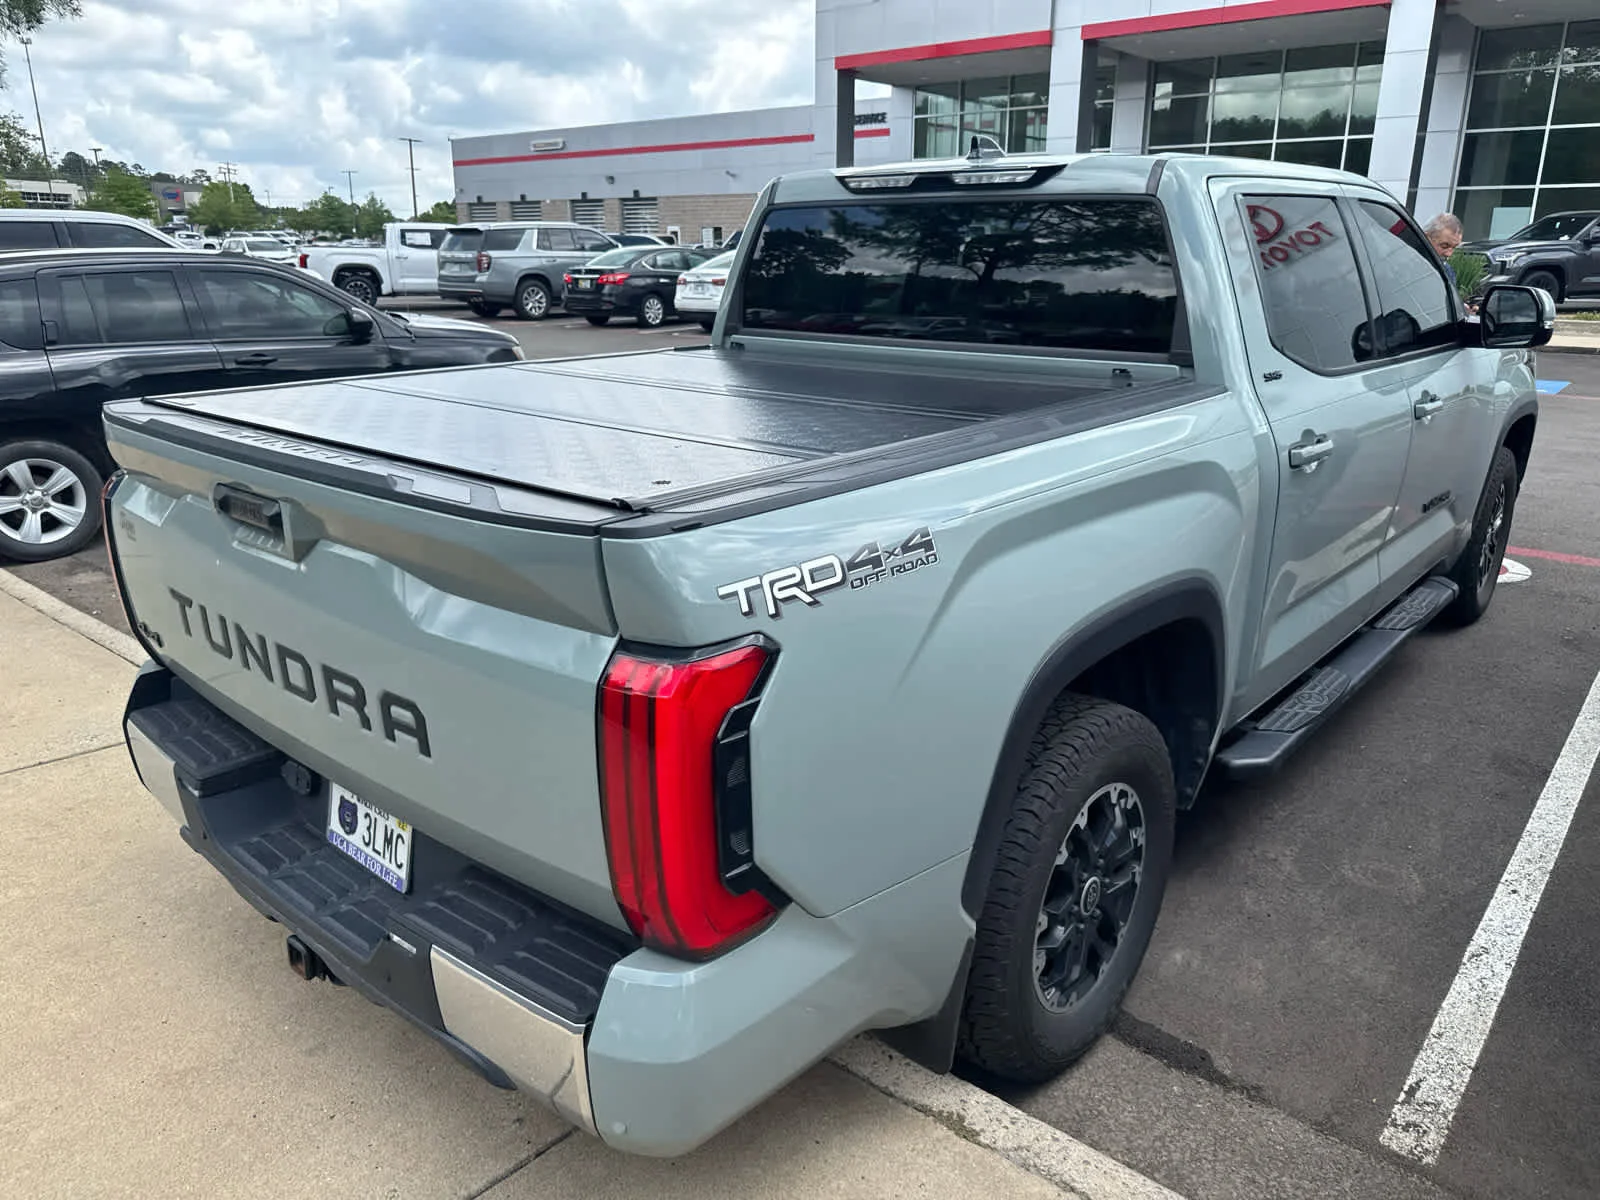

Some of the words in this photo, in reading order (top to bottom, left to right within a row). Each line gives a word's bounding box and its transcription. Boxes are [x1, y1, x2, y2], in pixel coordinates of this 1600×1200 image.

[716, 553, 847, 618] TRD
[850, 570, 887, 590] OFF
[890, 552, 939, 578] ROAD
[168, 586, 432, 758] TUNDRA
[333, 833, 348, 854] UCA
[348, 844, 367, 868] BEAR
[367, 857, 382, 878] FOR
[362, 812, 405, 869] 3LMC
